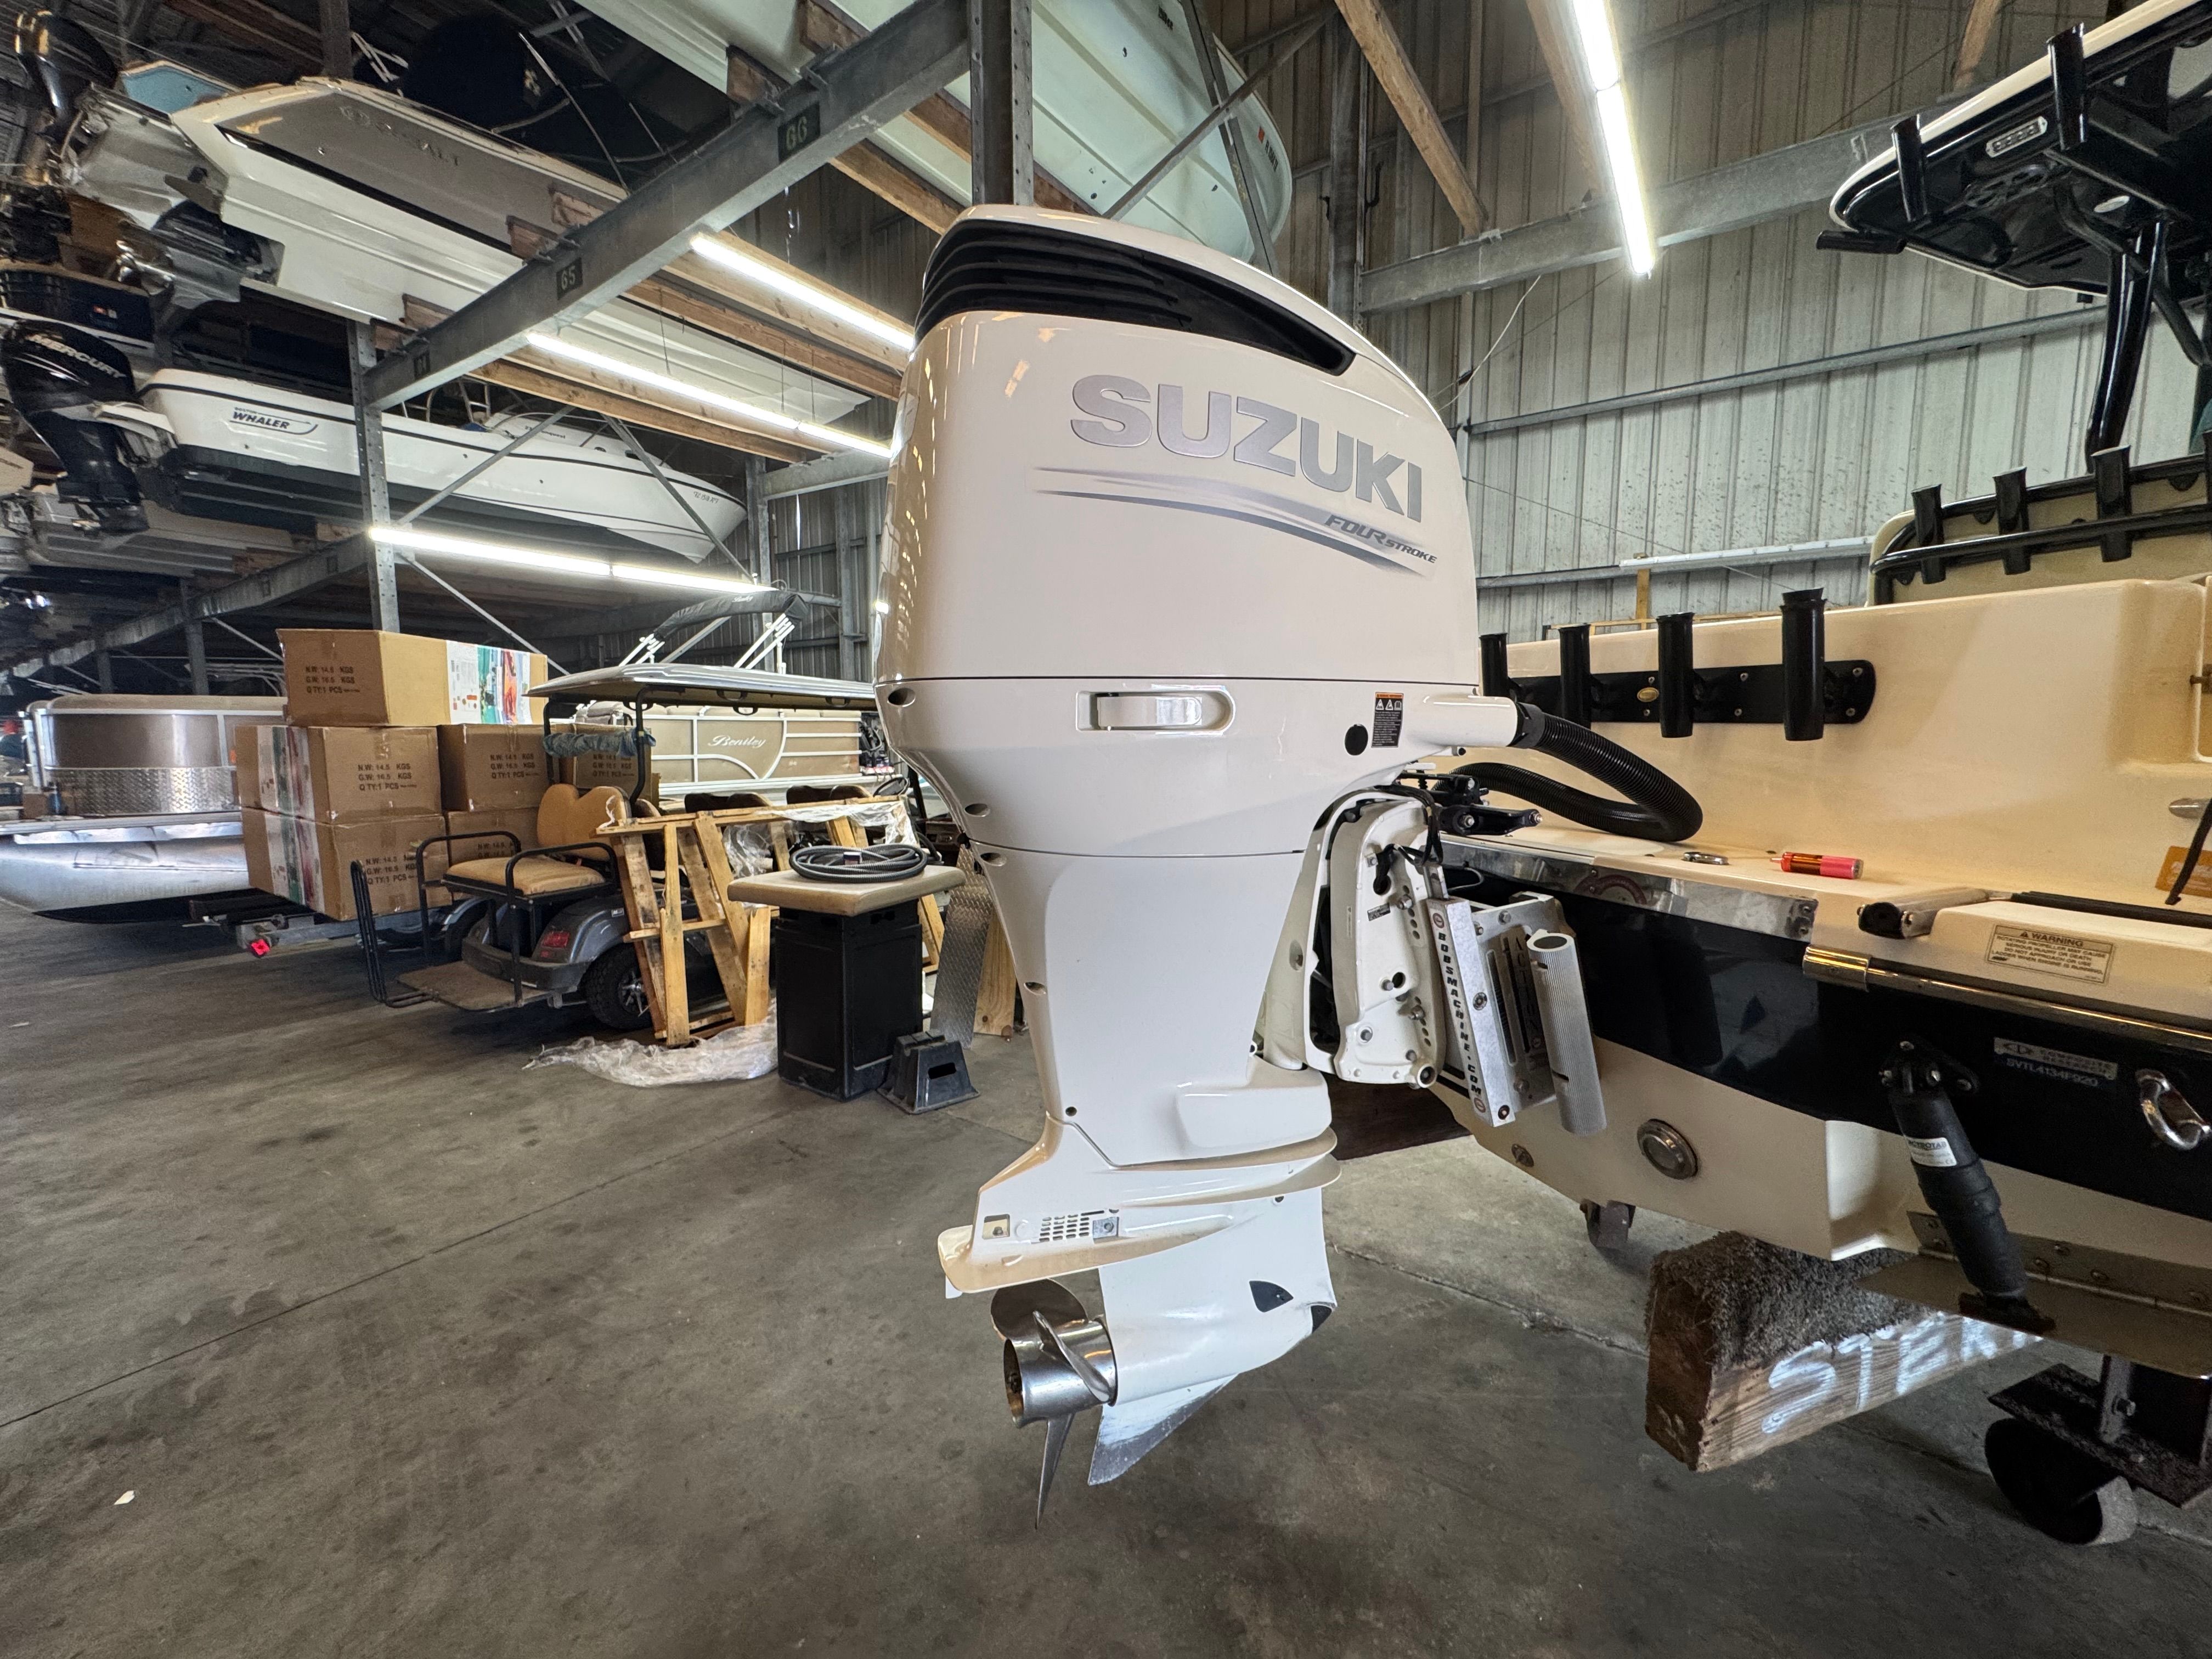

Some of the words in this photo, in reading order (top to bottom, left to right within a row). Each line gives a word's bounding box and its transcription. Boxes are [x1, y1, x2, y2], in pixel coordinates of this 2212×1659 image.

[786, 116, 808, 150] 66
[561, 266, 576, 290] 65
[233, 411, 290, 429] WHALER
[1071, 374, 1422, 523] SUZUKI
[1324, 515, 1387, 545] FOUR
[1385, 539, 1437, 563] STROKE
[707, 735, 766, 749] Bentley
[393, 873, 407, 882] PCS
[1996, 935, 2027, 944] ROTATING
[2028, 940, 2067, 951] PROPELLER
[2031, 932, 2084, 947] WARNING
[2029, 951, 2066, 961] APPROACH
[2069, 953, 2092, 961] DEATH
[1438, 931, 1482, 1097] BOBSMACHINE.COM
[1760, 1310, 2044, 1435] STER
